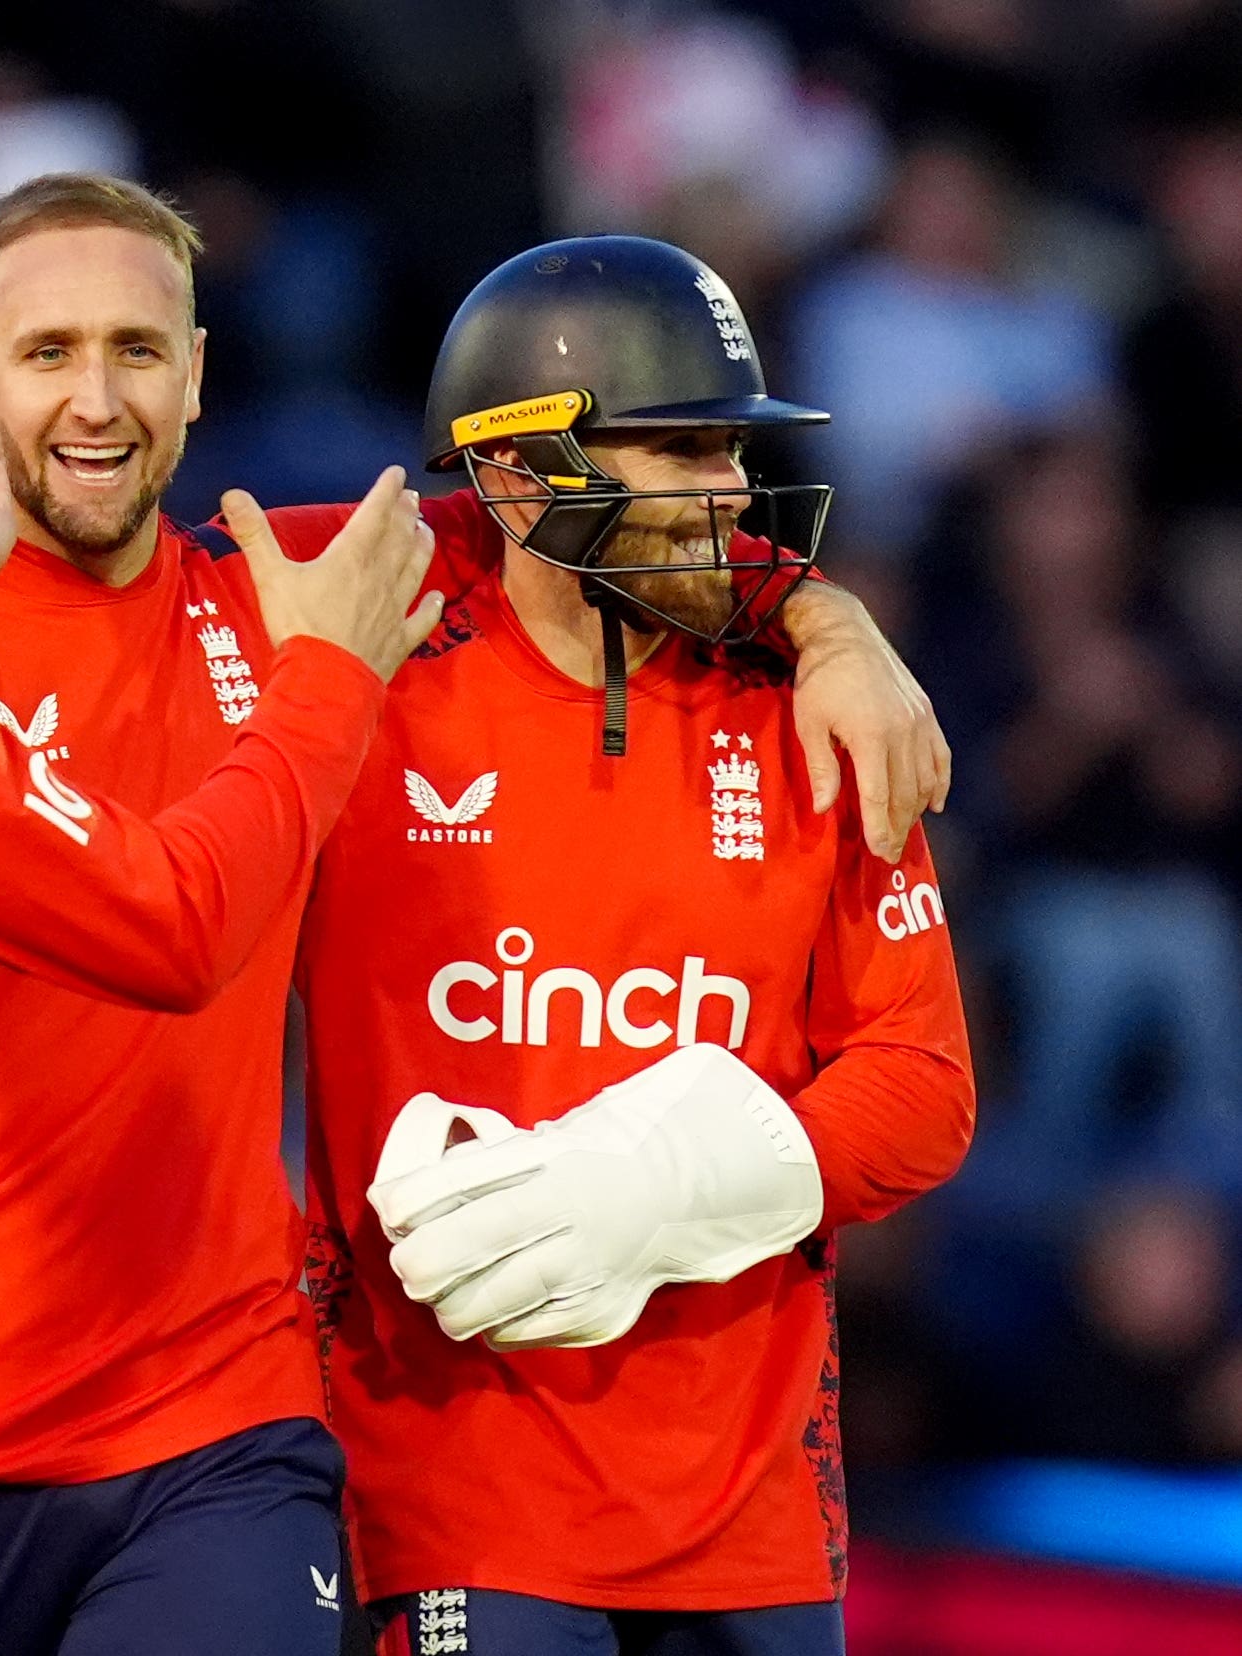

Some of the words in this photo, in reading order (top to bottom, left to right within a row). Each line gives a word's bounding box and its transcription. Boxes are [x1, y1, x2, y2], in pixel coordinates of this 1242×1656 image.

[489, 403, 557, 425] MASURI
[407, 828, 493, 844] CASTORE
[877, 869, 944, 941] cin
[427, 926, 750, 1050] cinch
